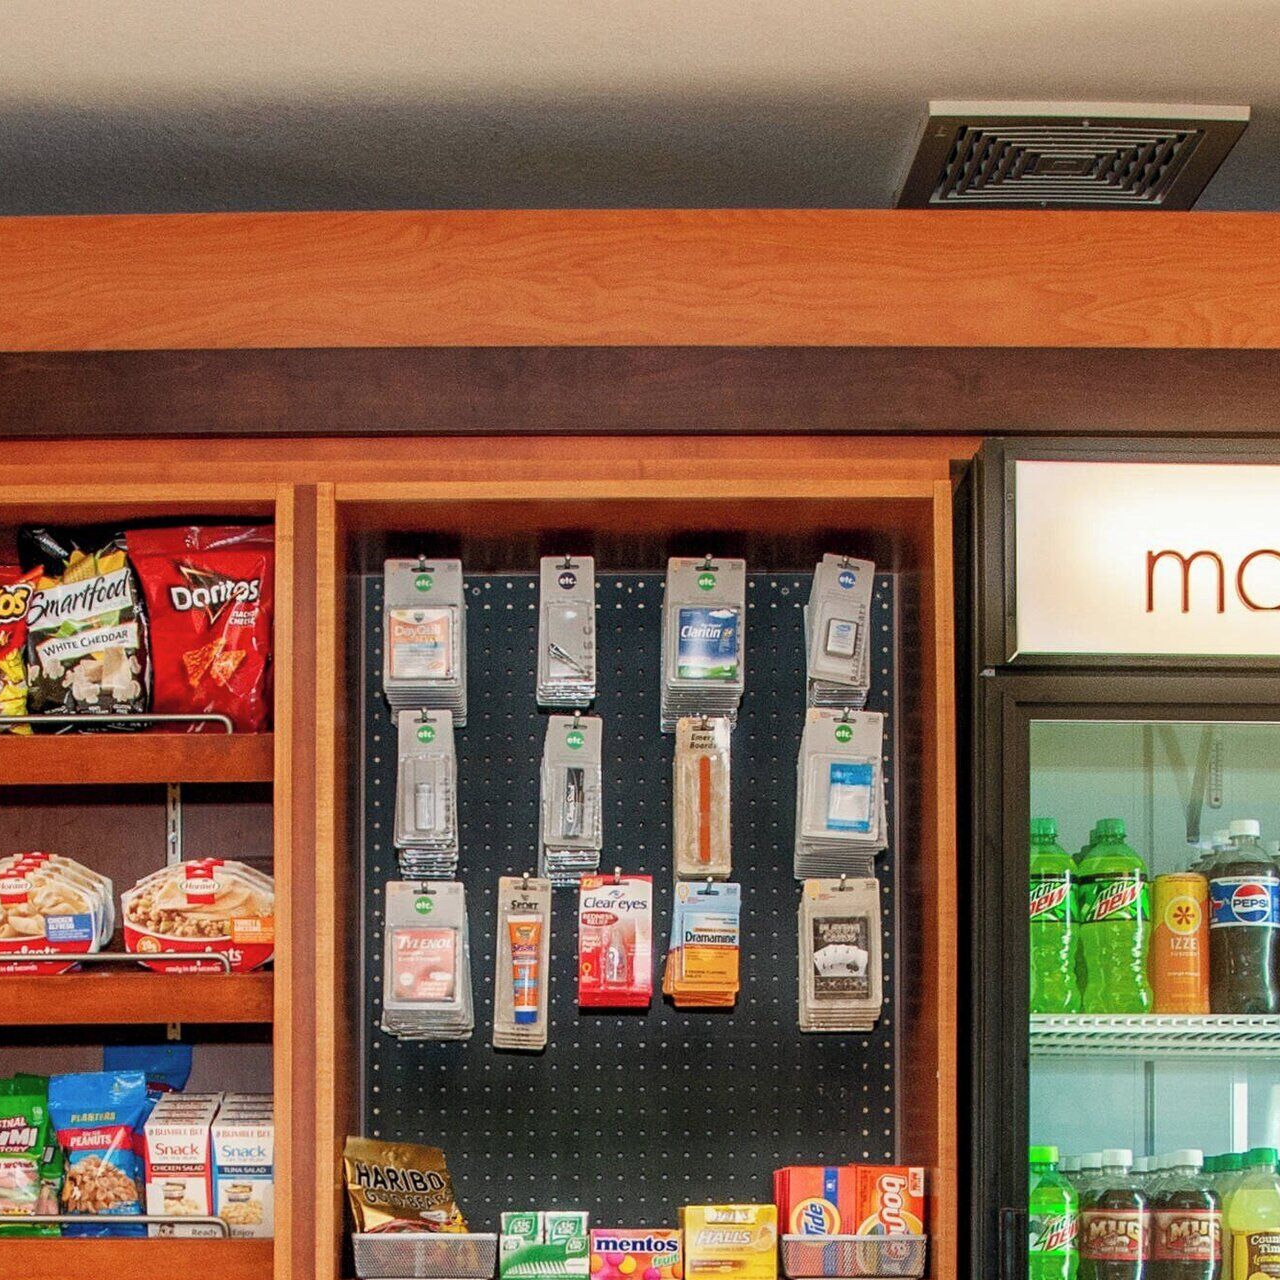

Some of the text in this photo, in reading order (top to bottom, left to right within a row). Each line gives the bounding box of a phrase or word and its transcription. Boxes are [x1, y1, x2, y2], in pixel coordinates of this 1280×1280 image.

[416, 578, 433, 588] etc.
[558, 576, 577, 586] etc.
[698, 577, 717, 587] etc.
[27, 575, 128, 625] Smartfood
[171, 580, 260, 611] Doritos
[681, 625, 721, 640] Claritin
[43, 630, 128, 658] WHITE CHEDDAR
[689, 741, 717, 749] Boards
[583, 897, 648, 912] Clear eyes
[398, 936, 452, 949] TYLENOL
[685, 931, 736, 944] Dramamine
[1170, 937, 1198, 949] IZZE
[70, 1134, 113, 1147] PEANUTS
[155, 1143, 199, 1156] Snack
[222, 1145, 266, 1158] Snack
[355, 1163, 445, 1193] HARIBO
[192, 1228, 217, 1238] Ready
[232, 1228, 255, 1238] Enjoy
[1089, 1221, 1141, 1238] MUG
[1170, 1222, 1220, 1238] MUG
[595, 1236, 679, 1252] mentos
[696, 1229, 752, 1246] HALLS
[653, 1253, 680, 1268] fruit
